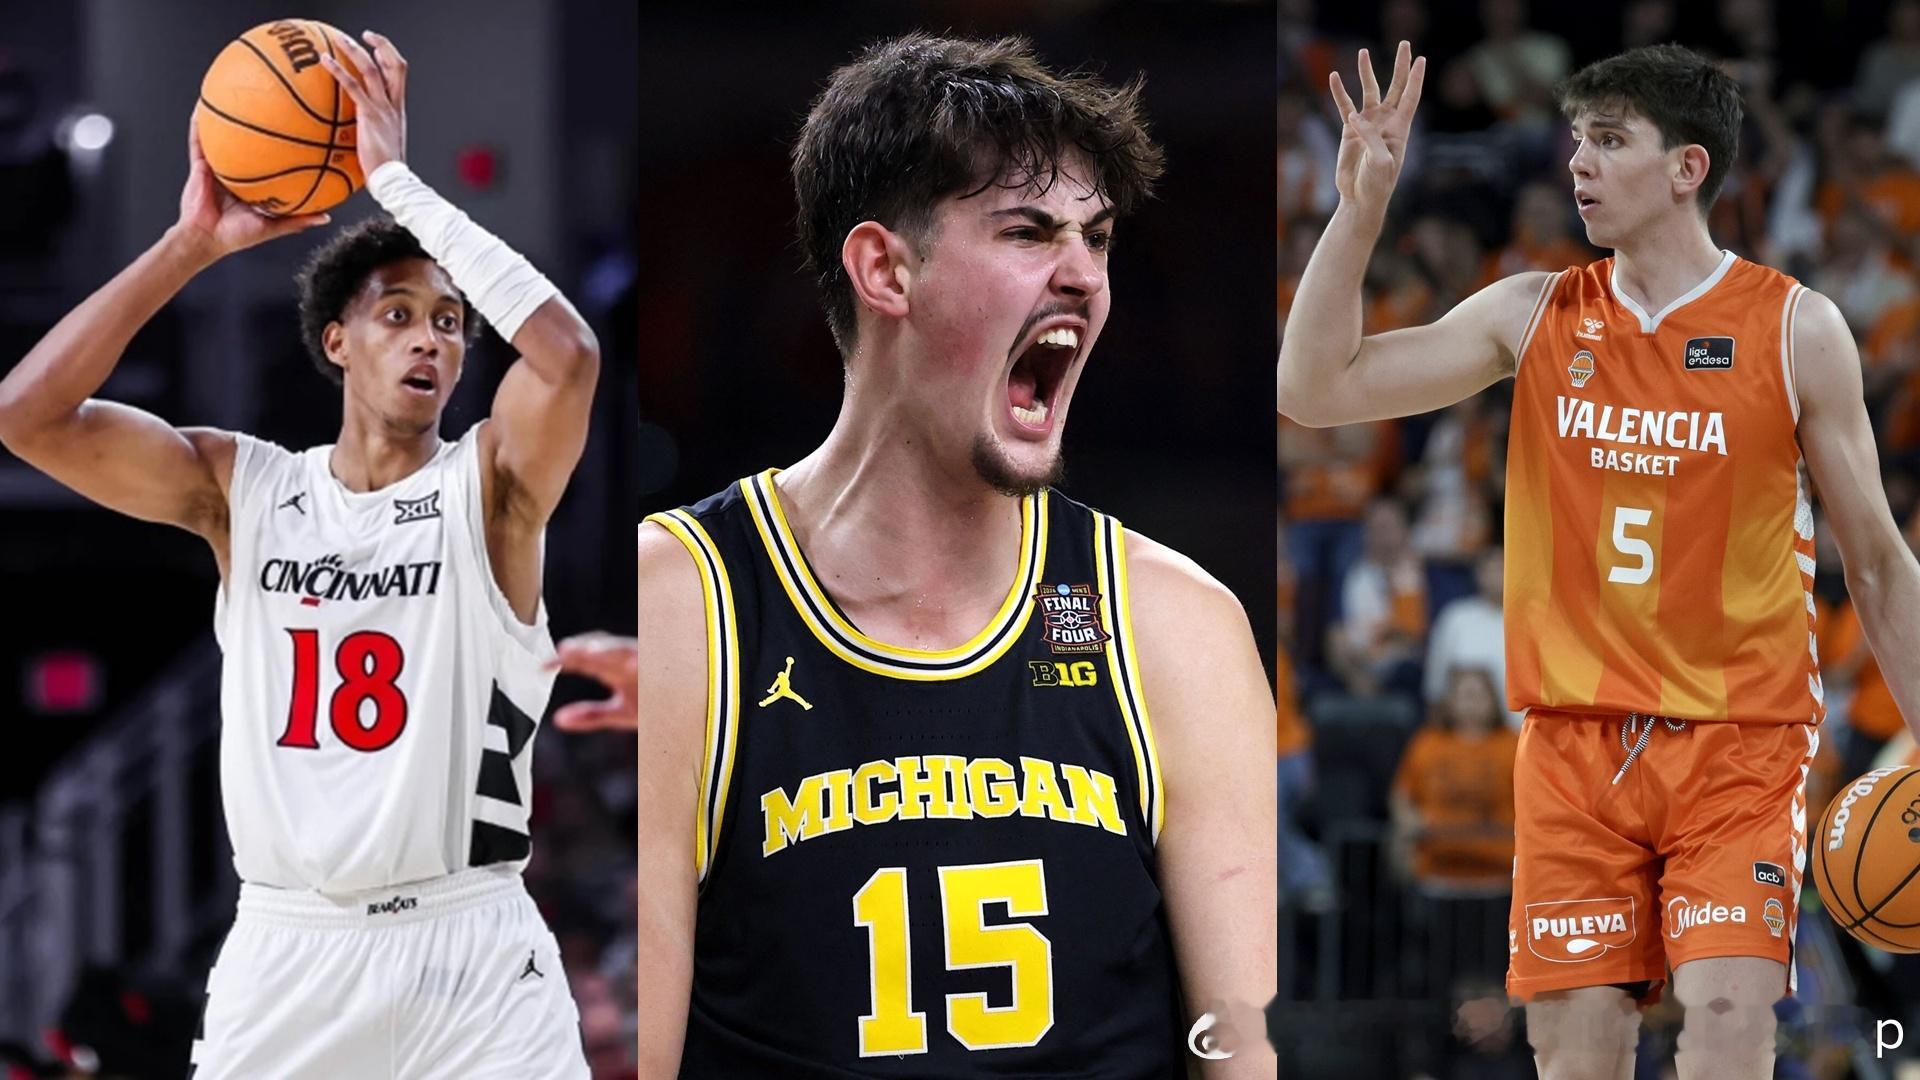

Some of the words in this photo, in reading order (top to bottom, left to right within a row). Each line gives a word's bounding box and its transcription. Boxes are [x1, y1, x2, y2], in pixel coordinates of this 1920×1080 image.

[1688, 355, 1730, 366] endesa
[1689, 347, 1708, 358] liga
[1556, 395, 1729, 457] VALENCIA
[1590, 446, 1681, 477] BASKET
[1607, 506, 1655, 585] 5
[260, 555, 442, 602] CINCINNATI
[1043, 597, 1091, 612] FINAL
[1052, 627, 1097, 643] FOUR
[1054, 644, 1100, 652] INDIANAPOLIS
[276, 627, 409, 753] 18
[761, 754, 1128, 858] MICHIGAN
[1757, 871, 1781, 884] acb
[1532, 912, 1628, 941] PULEVA
[1667, 895, 1747, 939] Midea
[852, 858, 1054, 1058] 15
